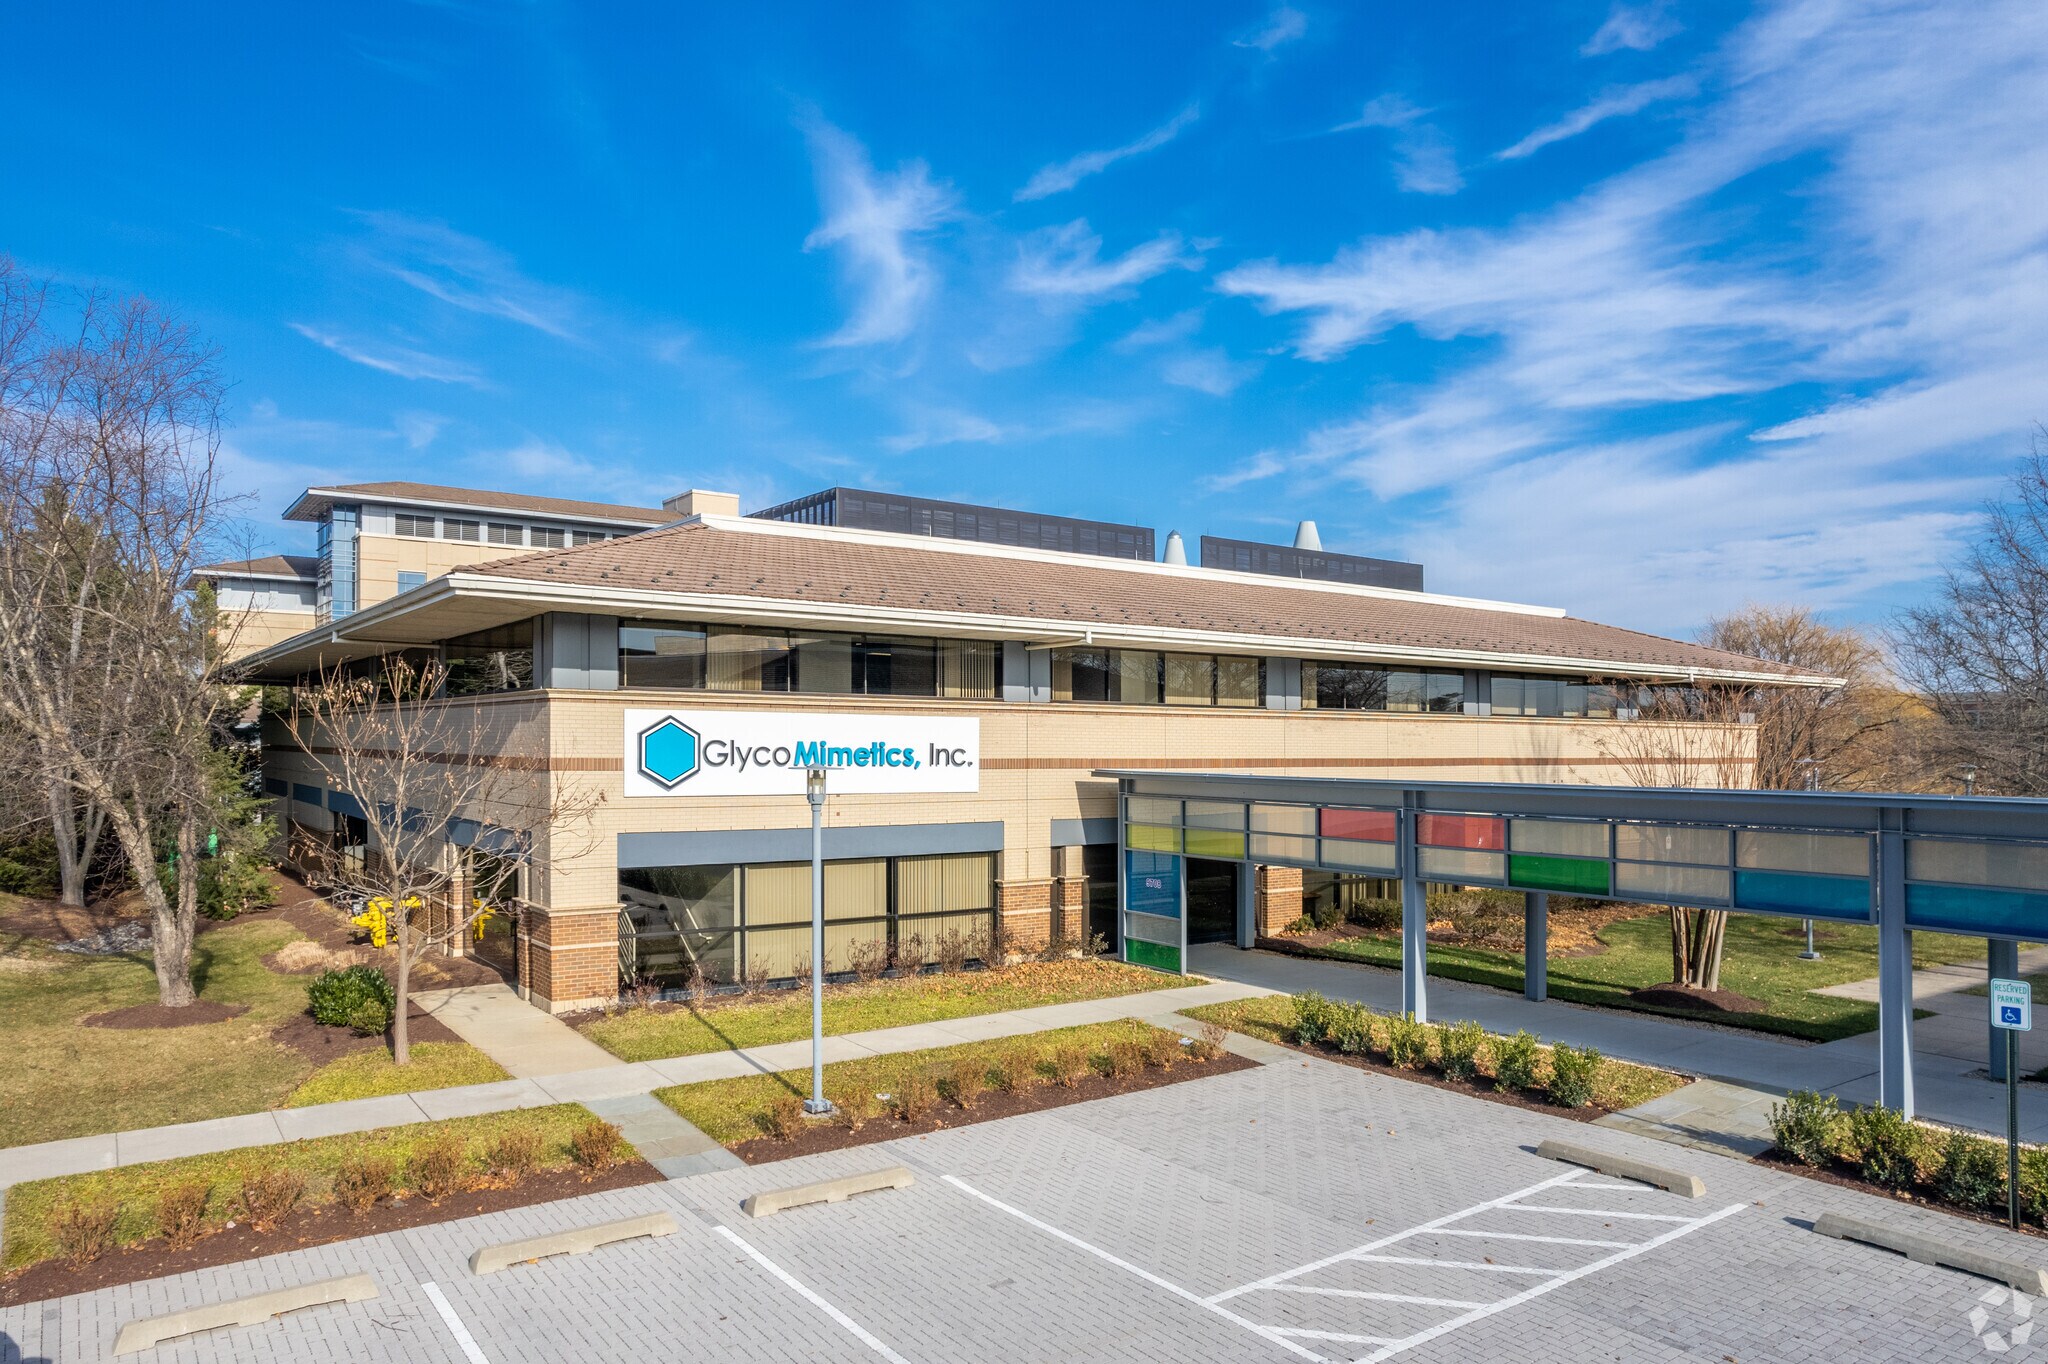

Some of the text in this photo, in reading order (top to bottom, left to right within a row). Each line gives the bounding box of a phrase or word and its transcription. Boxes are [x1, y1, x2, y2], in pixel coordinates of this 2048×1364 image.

[929, 742, 973, 767] Inc.
[1995, 984, 2027, 994] RESERVED
[1997, 995, 2025, 1005] PARKING
